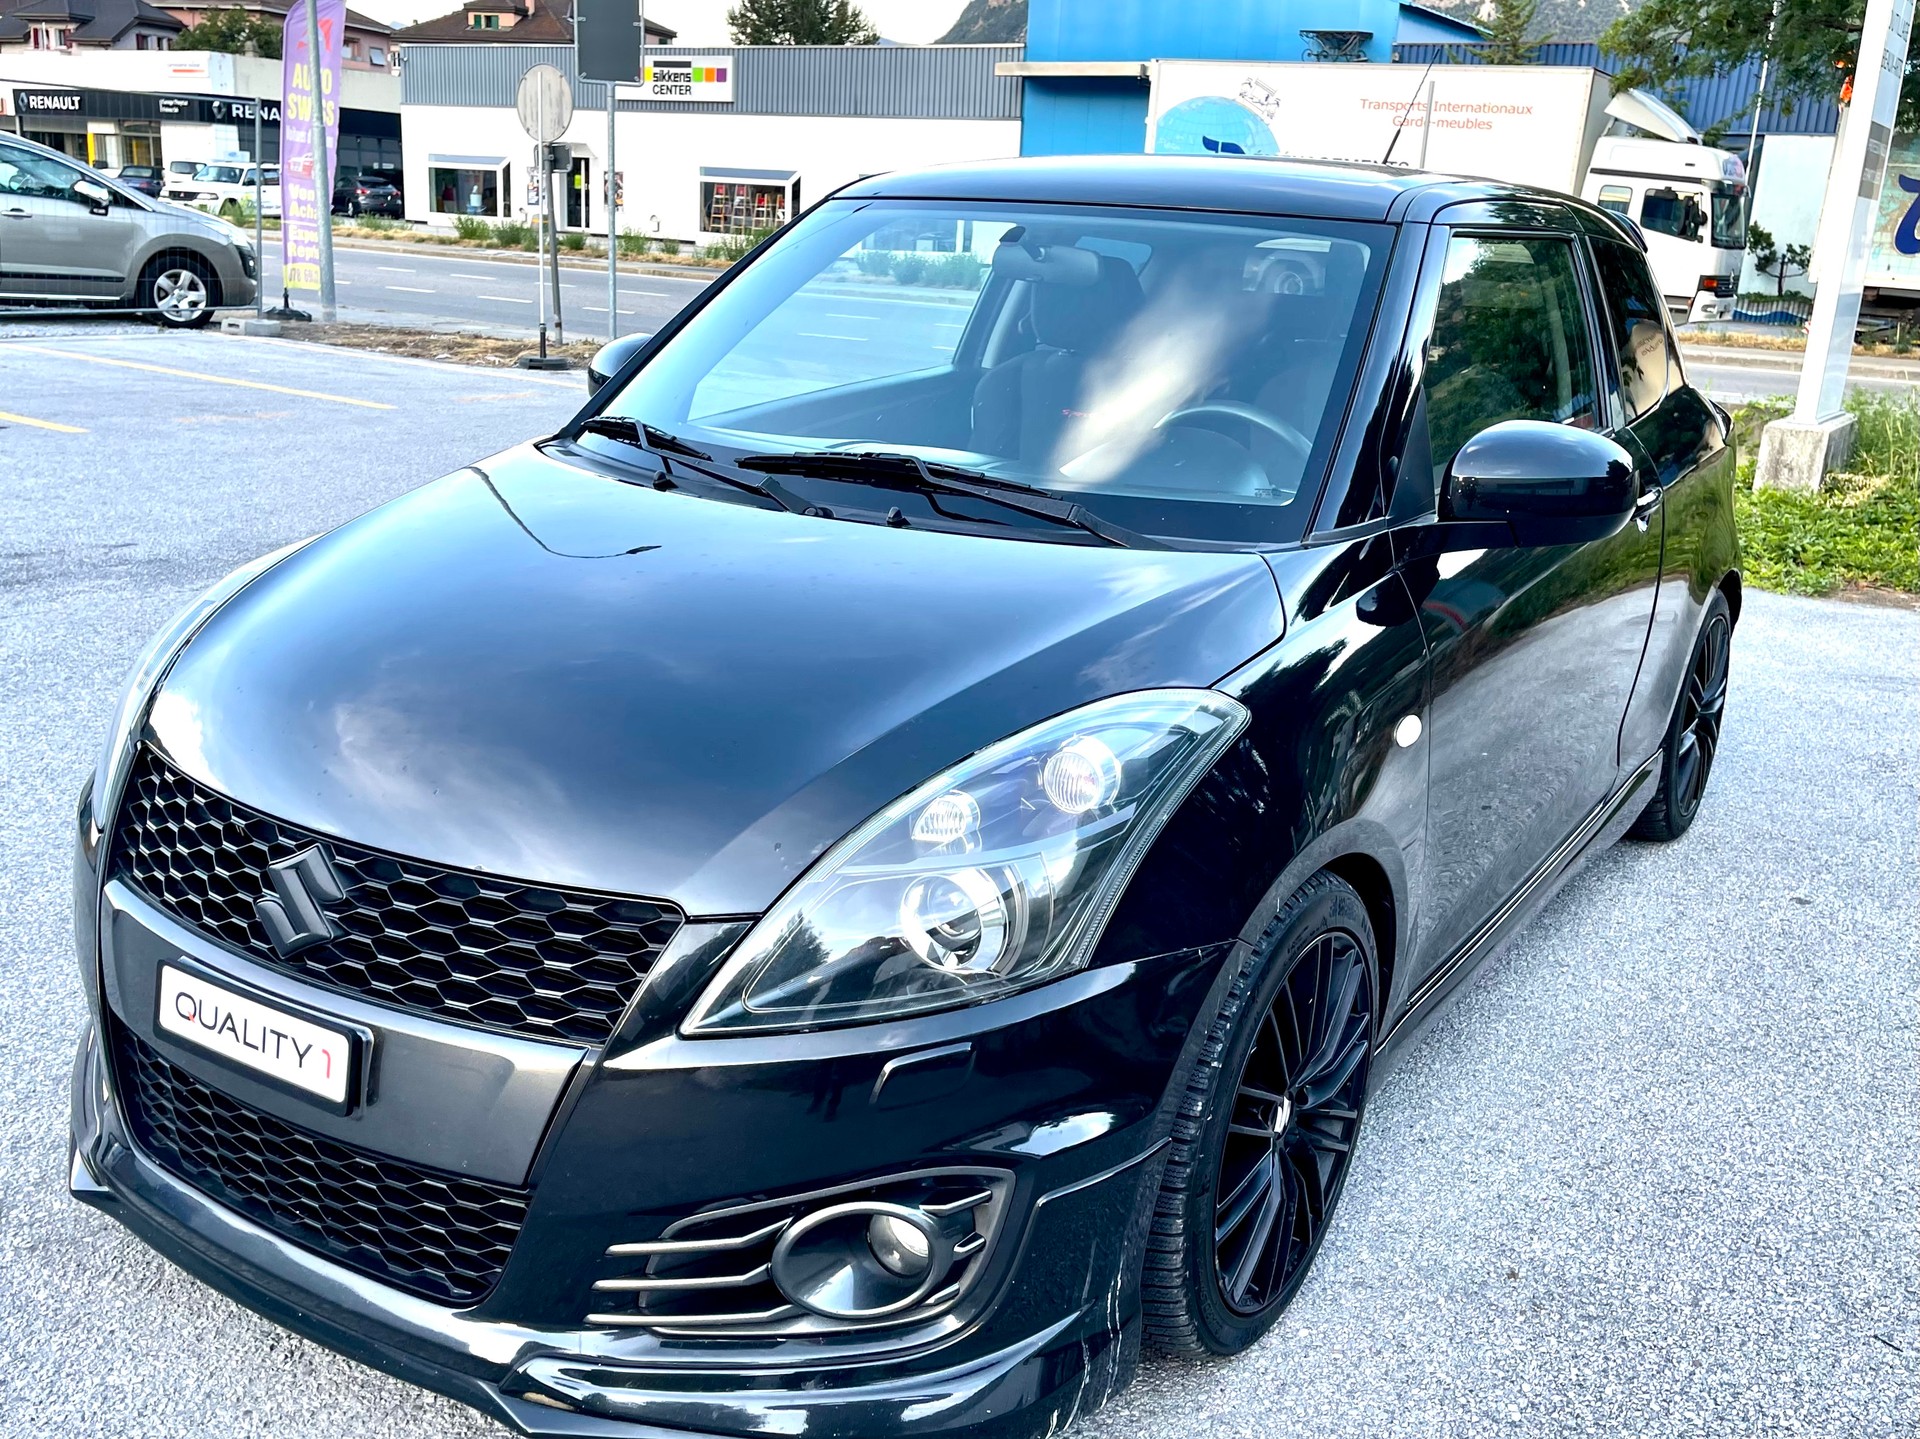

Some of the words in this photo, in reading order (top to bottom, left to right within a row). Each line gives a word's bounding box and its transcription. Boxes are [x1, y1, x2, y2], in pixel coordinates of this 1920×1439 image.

[292, 63, 332, 95] AUO
[653, 70, 691, 82] sikkens
[652, 84, 692, 95] CENTER
[29, 95, 81, 110] RENAULT
[1360, 98, 1428, 112] Transports
[1433, 100, 1533, 115] Internationaux
[231, 103, 281, 121] RENA
[288, 183, 315, 202] Ven
[289, 201, 317, 219] Ach
[175, 991, 313, 1068] QUALITY
[322, 1048, 331, 1079] 1
